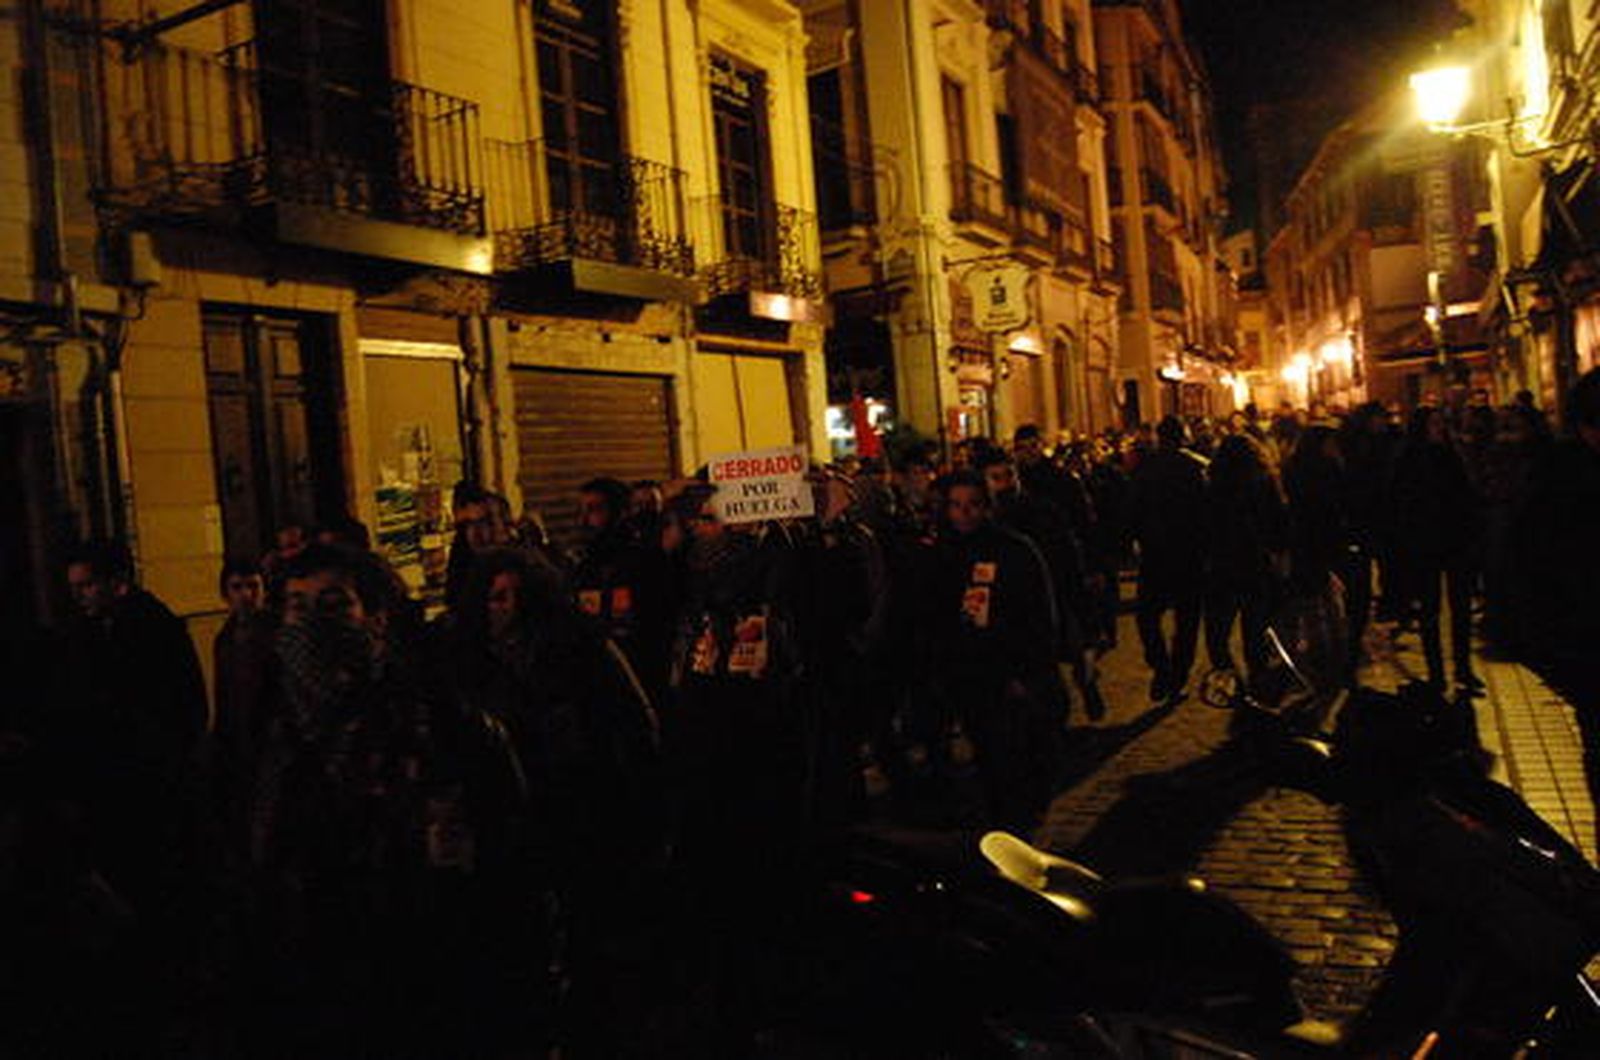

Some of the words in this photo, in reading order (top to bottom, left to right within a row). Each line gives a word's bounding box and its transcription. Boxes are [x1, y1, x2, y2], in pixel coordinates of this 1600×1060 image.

[713, 454, 802, 480] CERRADO
[741, 482, 779, 497] POR
[725, 498, 801, 517] HUELGA
